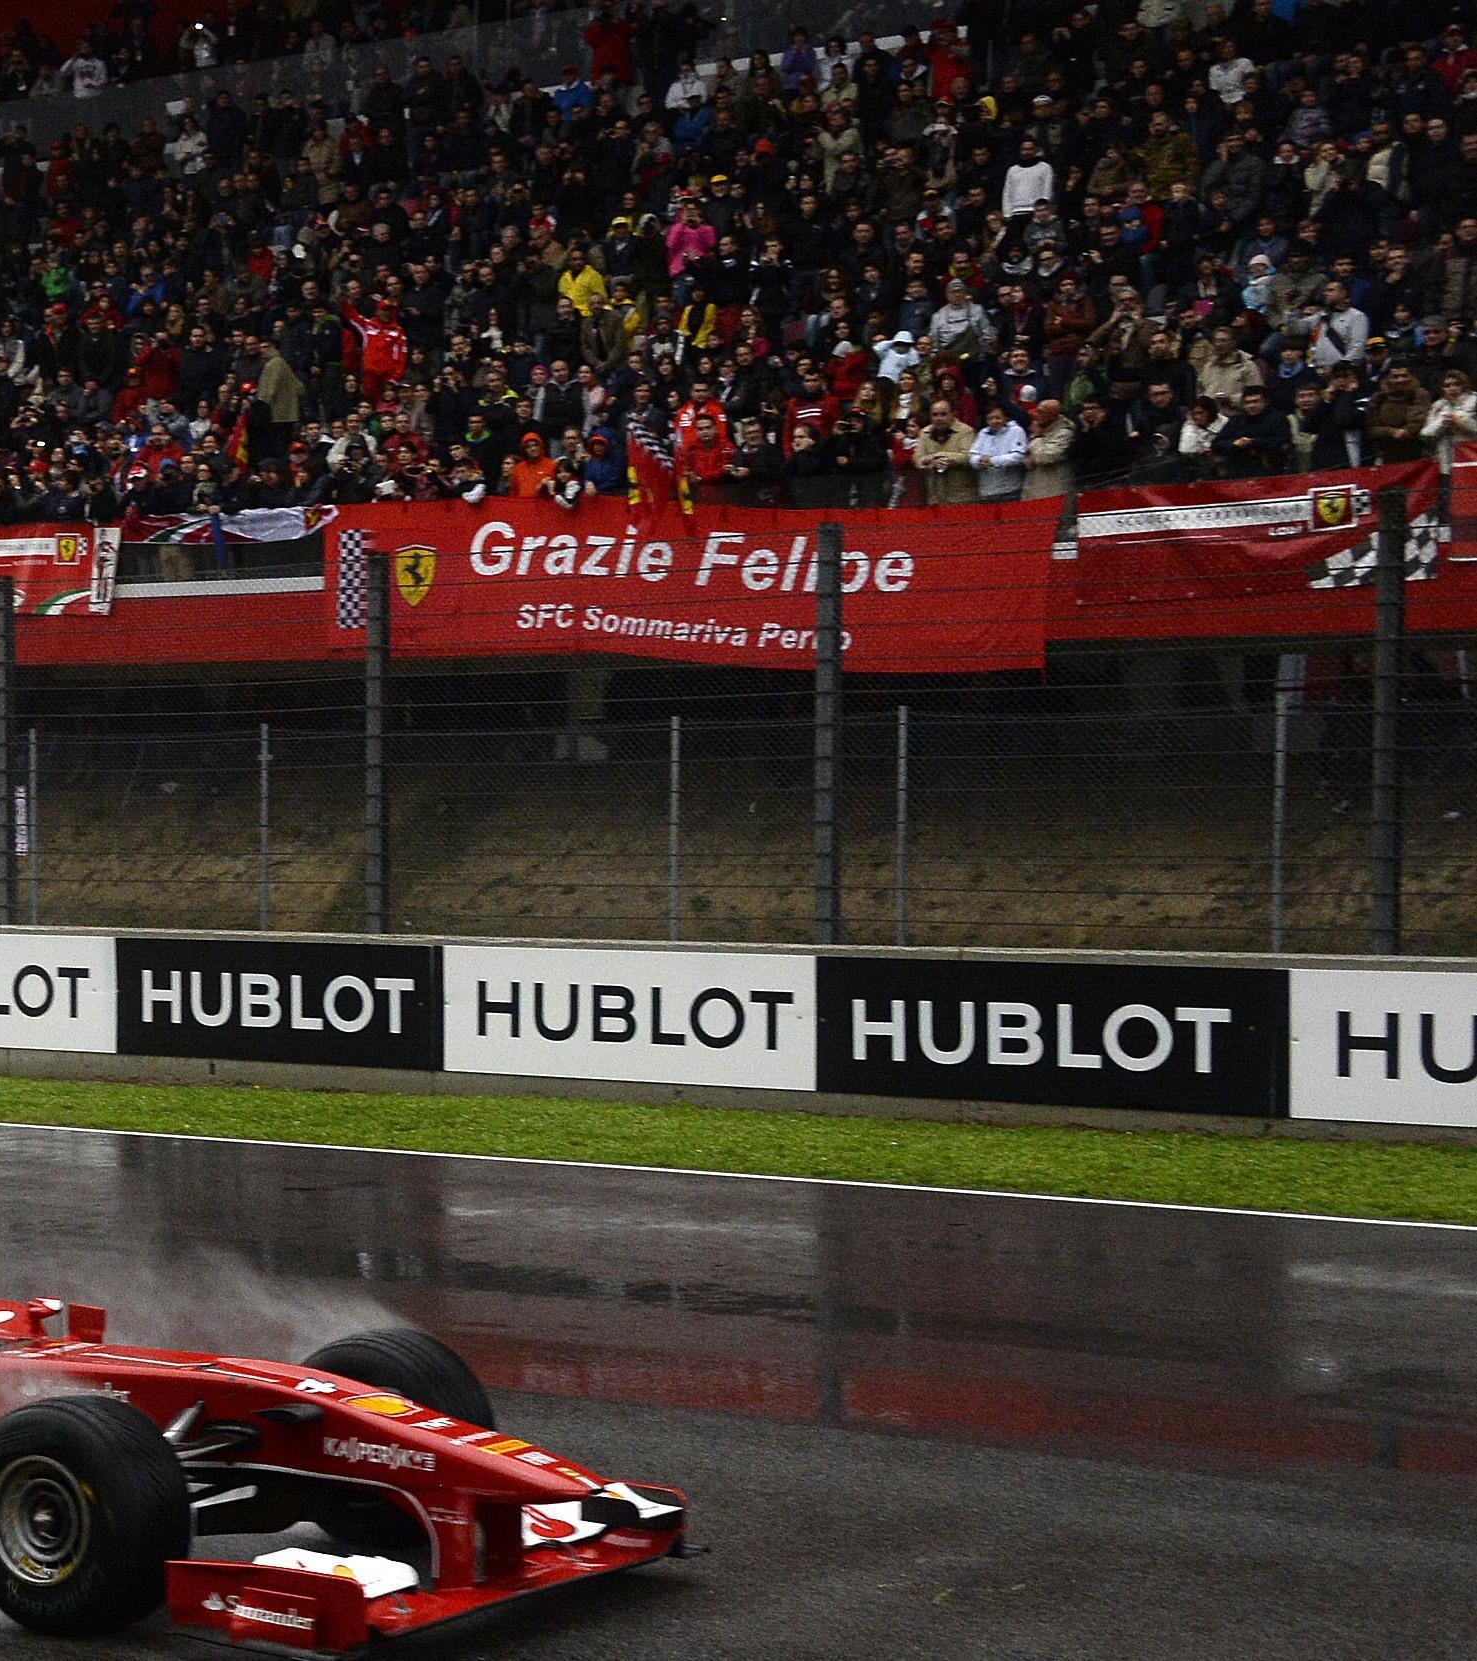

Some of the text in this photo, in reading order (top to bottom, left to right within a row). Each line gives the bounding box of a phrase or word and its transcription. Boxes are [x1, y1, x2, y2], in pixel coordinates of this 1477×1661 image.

[470, 521, 673, 582] Grazie
[516, 603, 852, 652] SFC Sommariva Pero
[140, 969, 415, 1035] HUBLOT
[476, 979, 793, 1052] HUBLOT
[851, 998, 1232, 1075] HUBLOT
